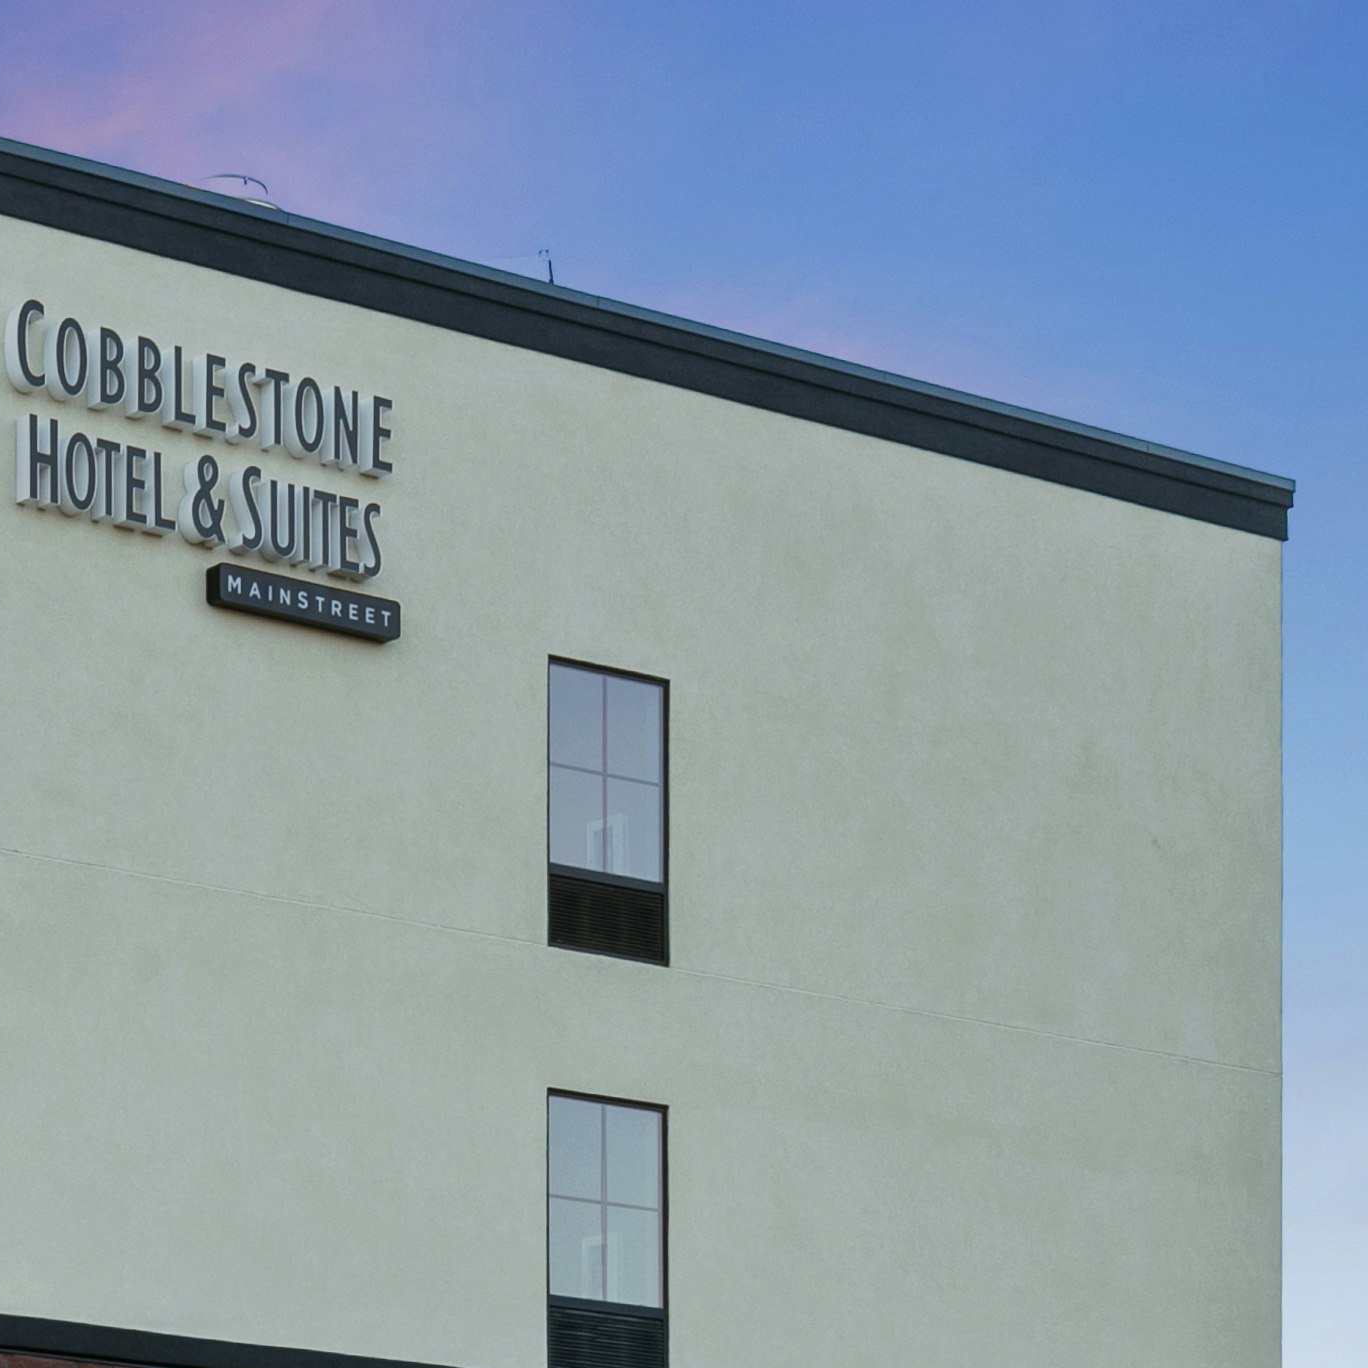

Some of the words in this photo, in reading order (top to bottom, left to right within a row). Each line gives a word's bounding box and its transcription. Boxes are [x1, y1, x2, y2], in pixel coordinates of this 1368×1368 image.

[7, 300, 394, 476] COBBLESTONE
[18, 413, 176, 535] HOTEL
[186, 454, 227, 546] &
[233, 466, 382, 579] SUITES
[227, 574, 393, 628] MAINSTREET
